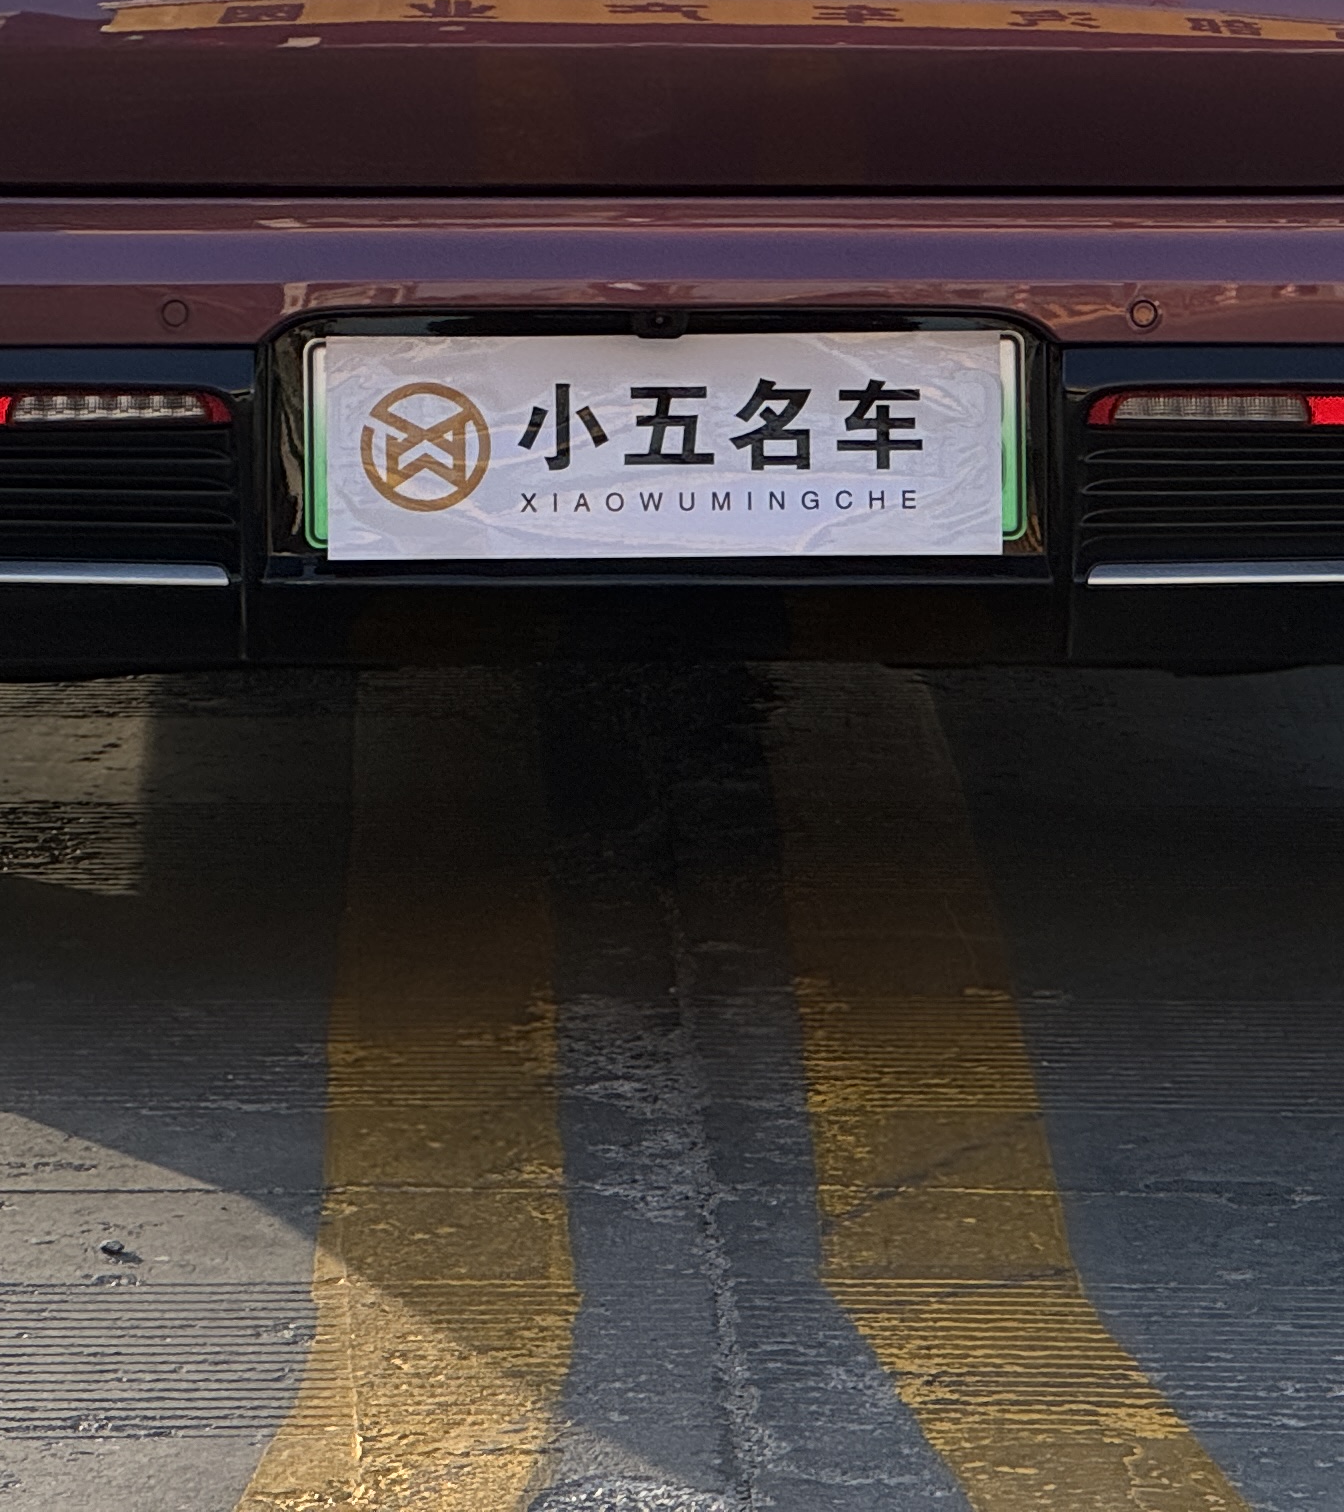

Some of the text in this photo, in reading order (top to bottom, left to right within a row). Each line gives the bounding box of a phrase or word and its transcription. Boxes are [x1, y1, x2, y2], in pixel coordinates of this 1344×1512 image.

[518, 377, 924, 471] 小五名车
[521, 489, 920, 513] XIAOWUMINGCHE
